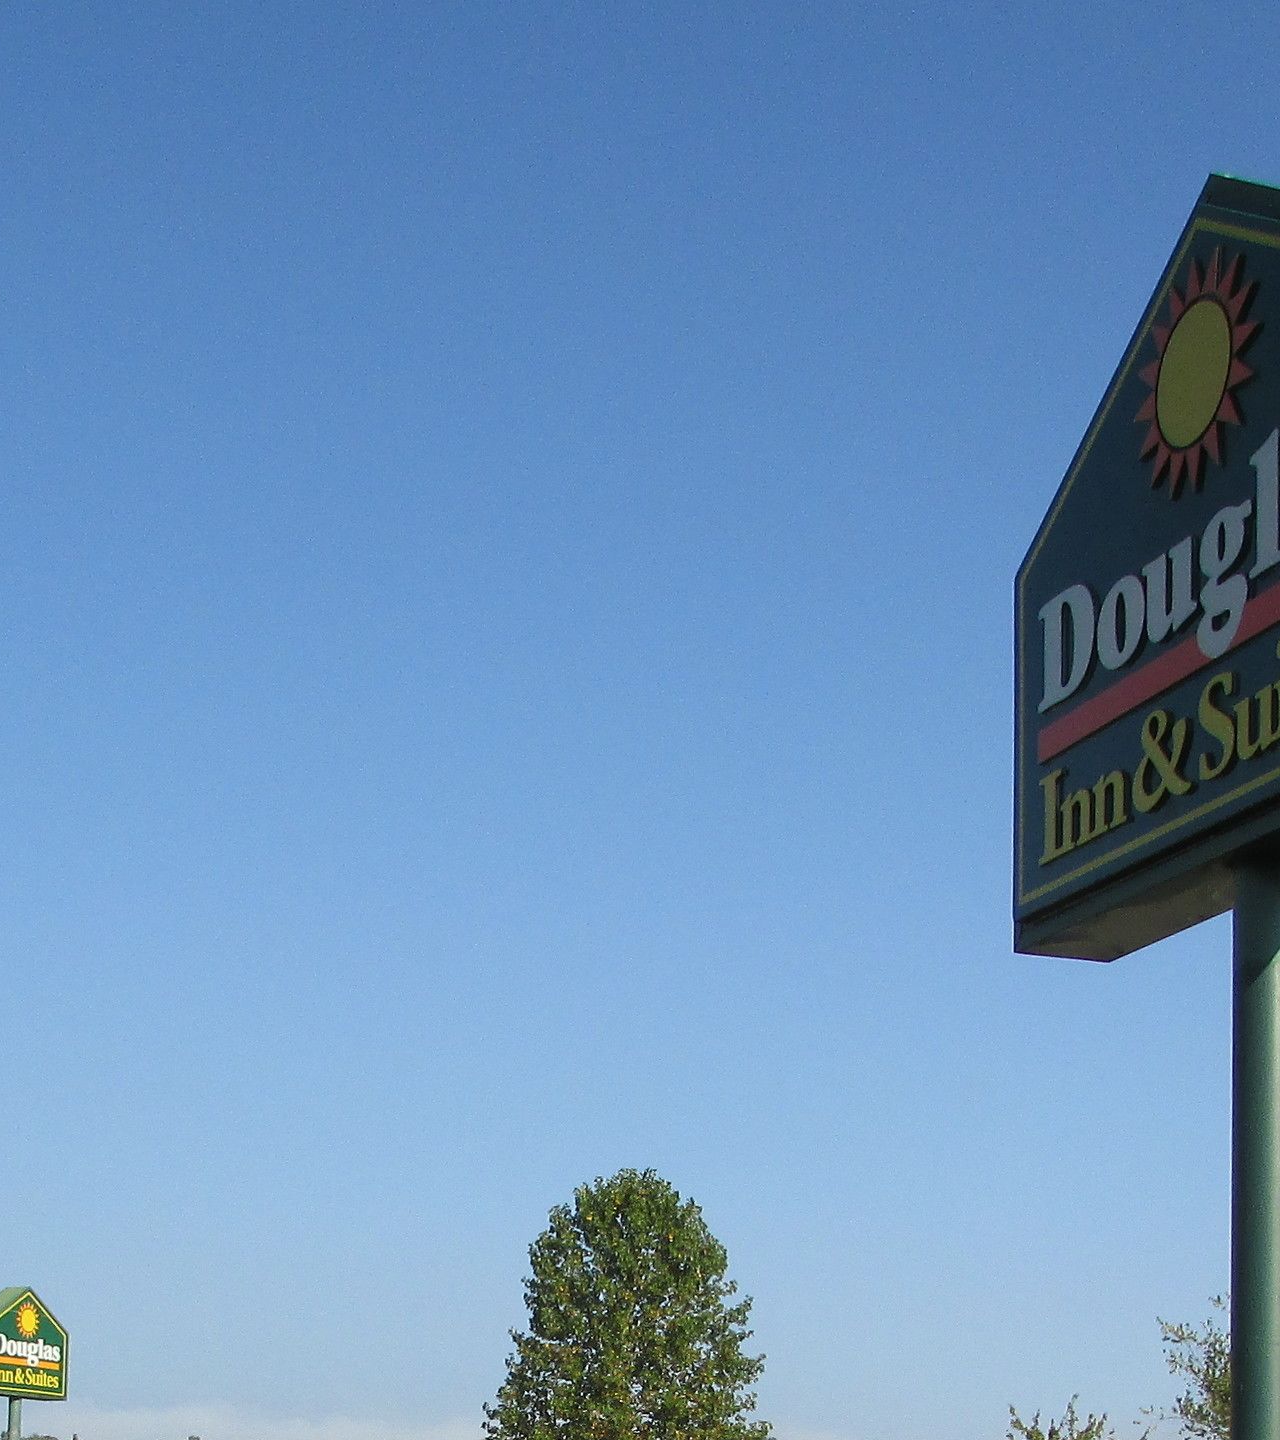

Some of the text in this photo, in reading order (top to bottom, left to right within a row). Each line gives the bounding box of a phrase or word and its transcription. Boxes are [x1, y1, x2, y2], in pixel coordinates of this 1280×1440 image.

[1039, 766, 1128, 866] Inn
[1131, 709, 1195, 811] &
[14, 1367, 25, 1385] &
[25, 1368, 59, 1389] Suites
